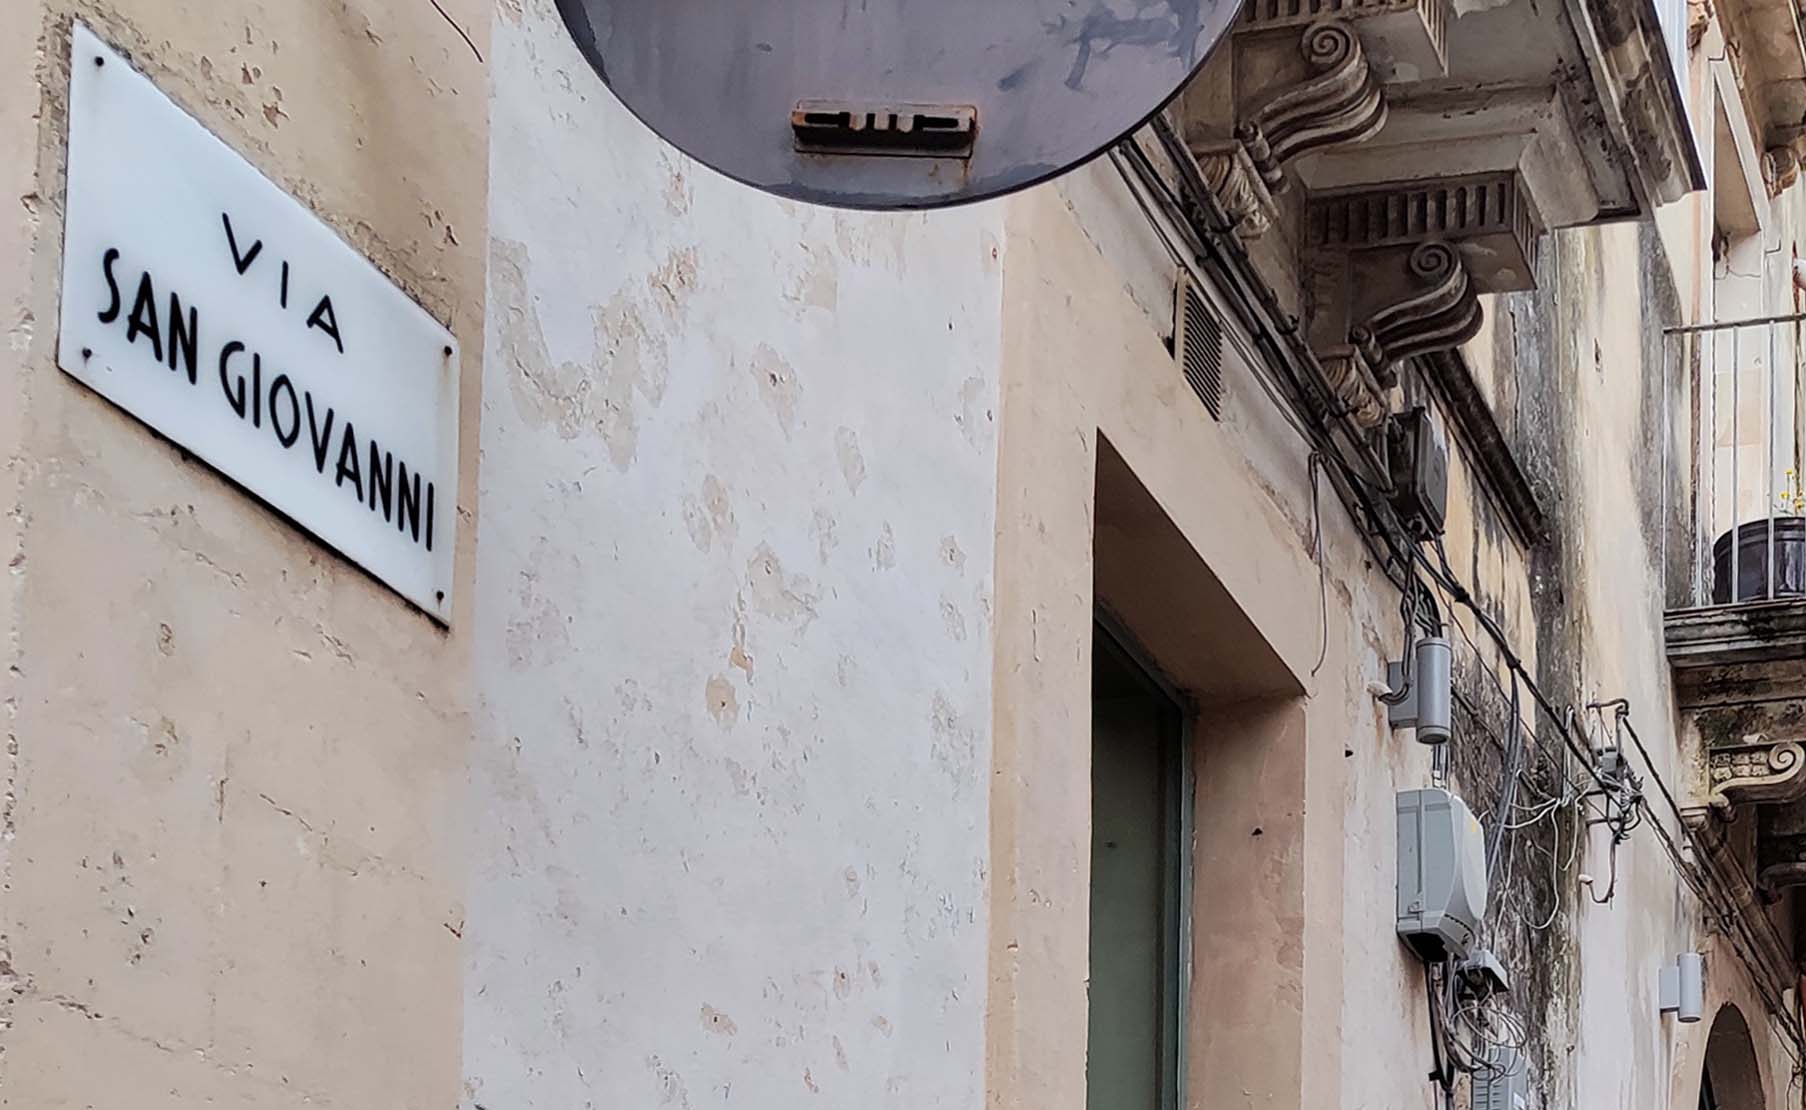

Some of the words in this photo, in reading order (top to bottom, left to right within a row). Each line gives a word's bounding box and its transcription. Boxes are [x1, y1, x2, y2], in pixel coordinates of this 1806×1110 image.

[221, 211, 345, 355] VIA
[97, 247, 198, 386] SAN
[218, 340, 436, 552] GIOVANNI
